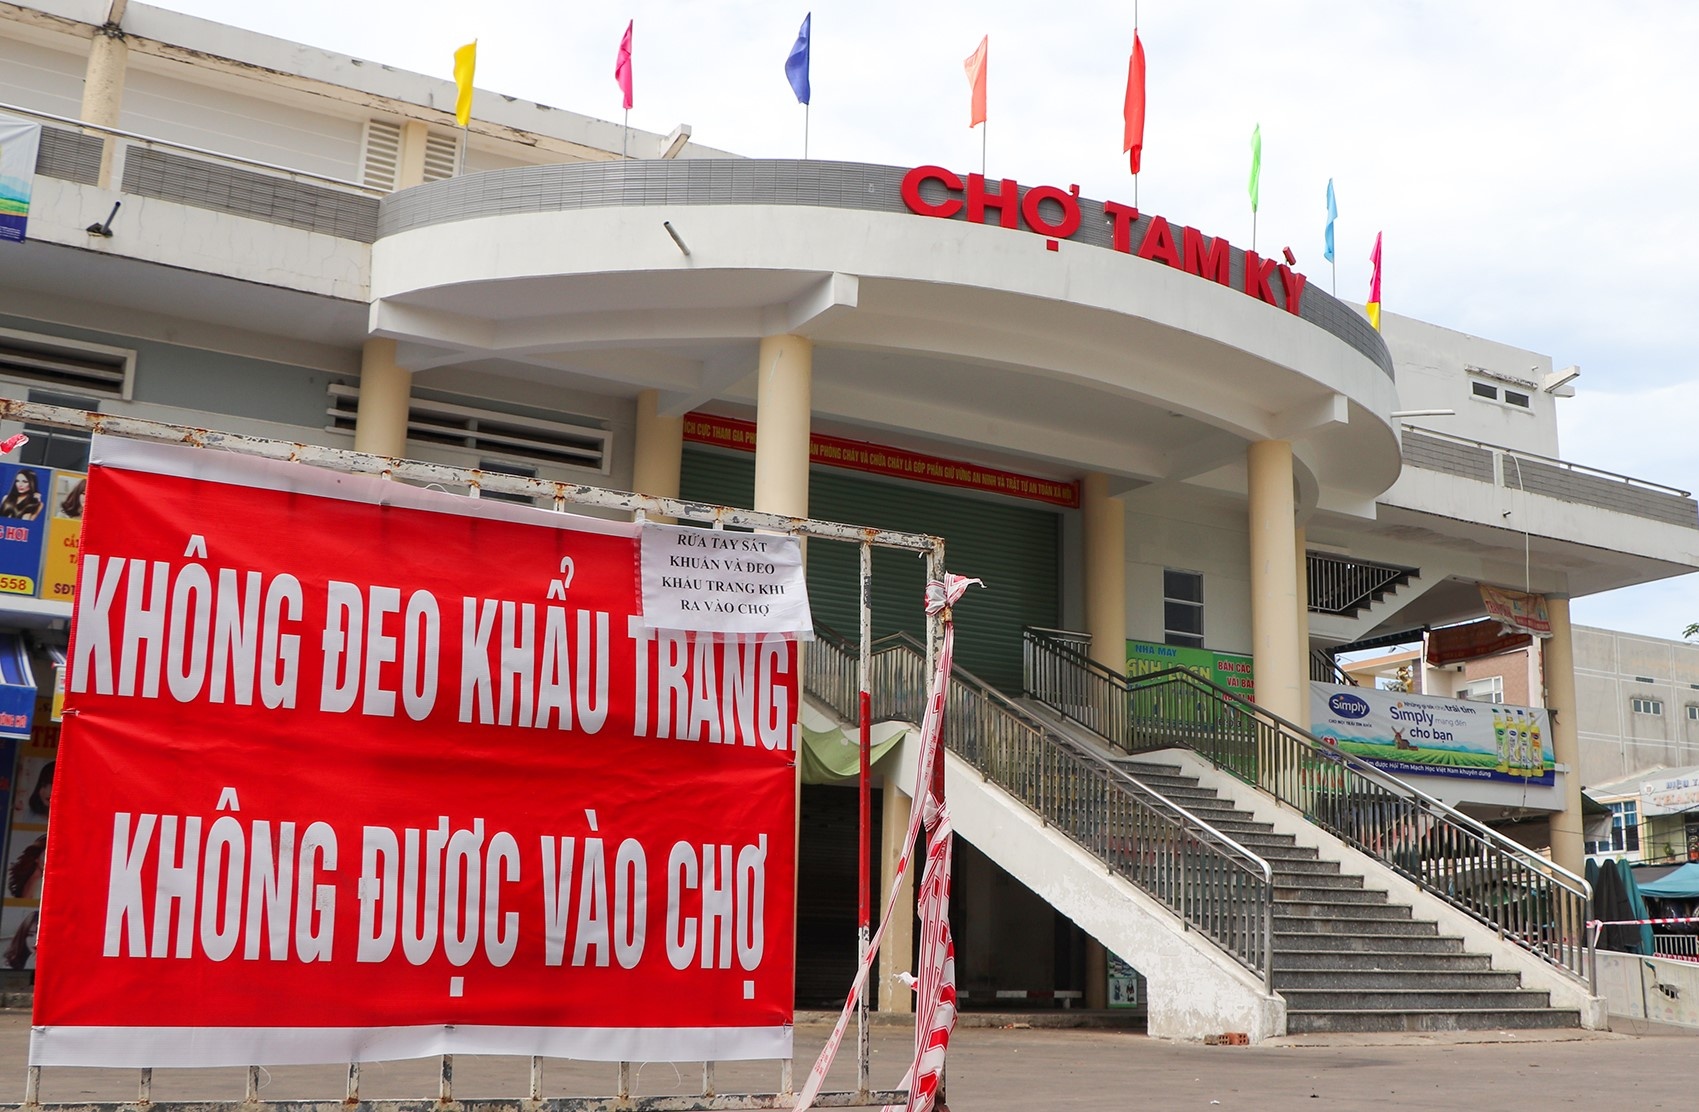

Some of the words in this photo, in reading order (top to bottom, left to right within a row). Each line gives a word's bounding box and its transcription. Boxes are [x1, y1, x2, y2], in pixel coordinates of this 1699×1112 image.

[900, 165, 1081, 252] CHỢ
[1104, 200, 1230, 288] TAM
[1244, 246, 1307, 316] KỲ
[732, 429, 744, 442] GIA
[711, 537, 739, 550] TAY
[742, 538, 768, 552] SÁT
[724, 558, 742, 572] VÀ
[747, 562, 775, 575] ĐEO
[706, 580, 755, 594] TRANG
[759, 584, 785, 595] KHI
[681, 599, 700, 611] RA
[704, 598, 734, 614] VÀO
[737, 603, 770, 617] CHỢ
[70, 534, 304, 710] KHÔNG
[320, 580, 441, 722] ĐEO
[458, 556, 610, 735] KHẨU
[1332, 695, 1367, 715] Simply
[1389, 701, 1434, 727] Simply
[1460, 706, 1476, 715] tim
[1410, 726, 1431, 739] cho
[1432, 728, 1454, 743] bạn
[102, 786, 338, 964] KHÔNG
[356, 815, 521, 997] ĐƯỢC
[540, 808, 648, 970] VÀO
[665, 833, 768, 1000] CHỢ
